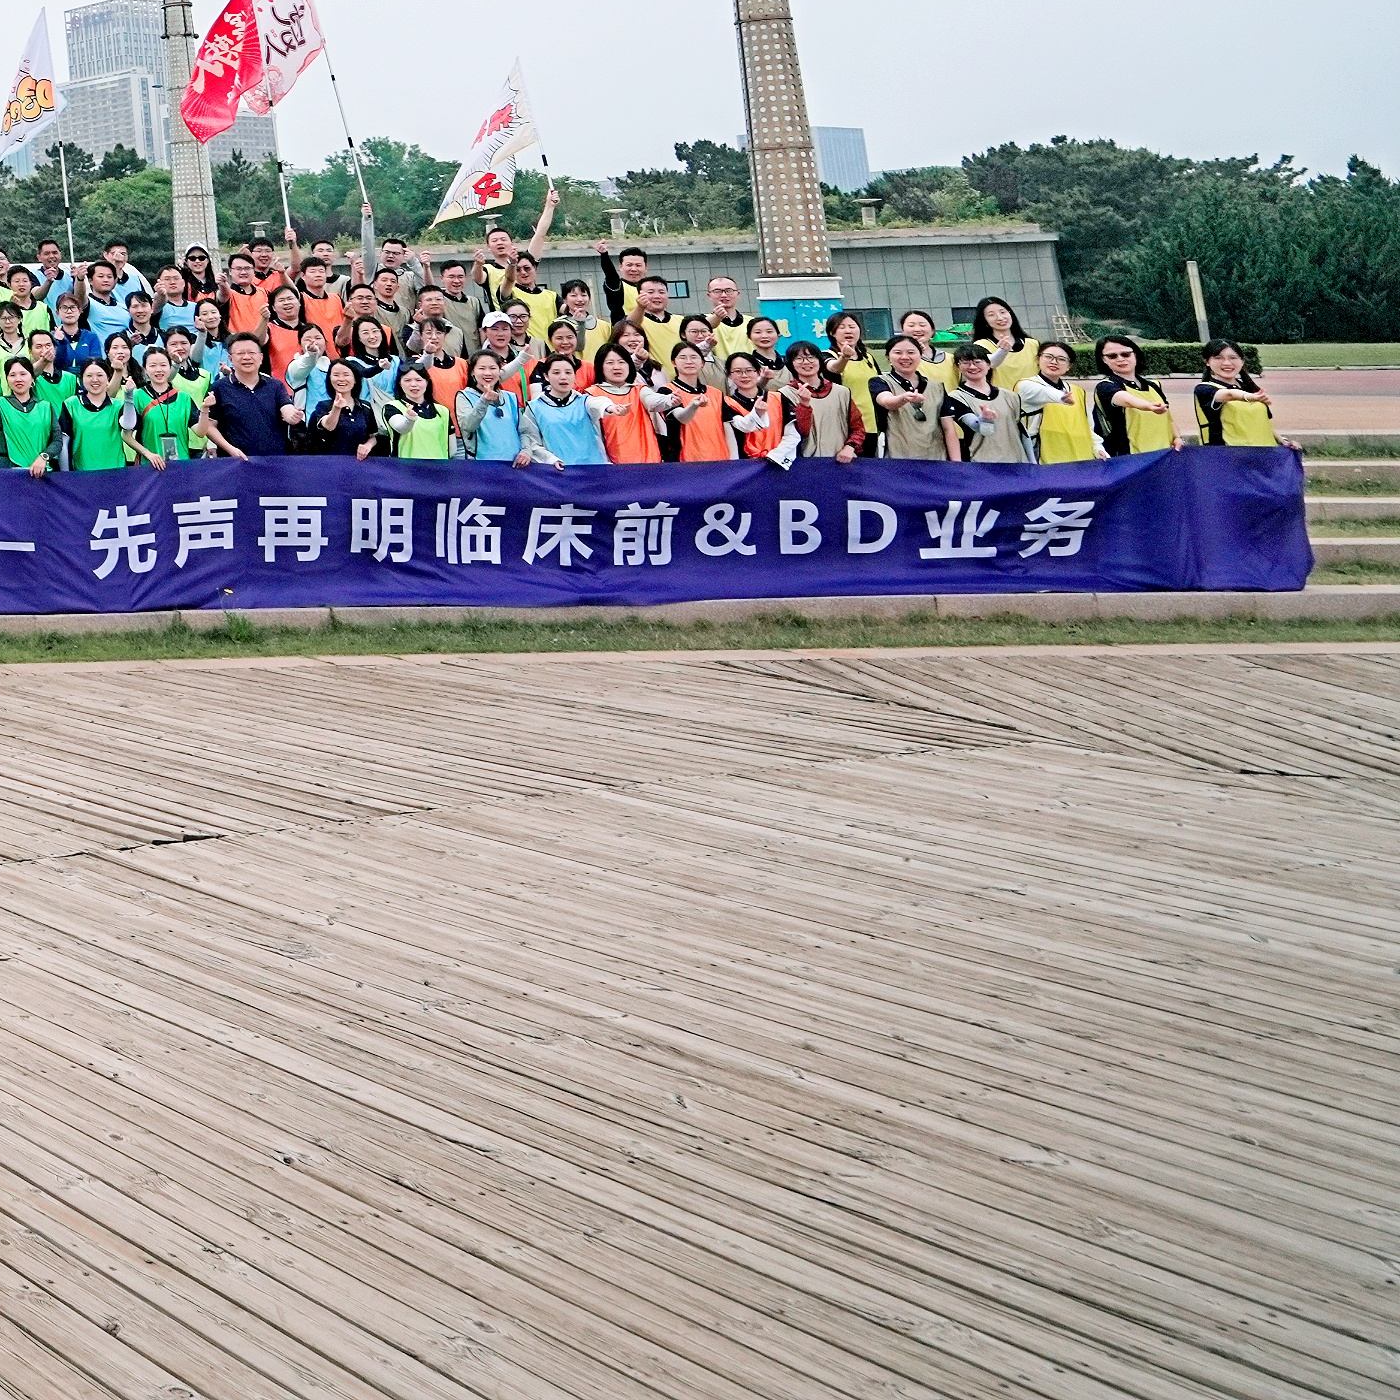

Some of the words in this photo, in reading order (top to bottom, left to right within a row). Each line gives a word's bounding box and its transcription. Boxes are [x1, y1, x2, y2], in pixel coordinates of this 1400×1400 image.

[89, 495, 1095, 580] 先声再明临床前&BD业务
